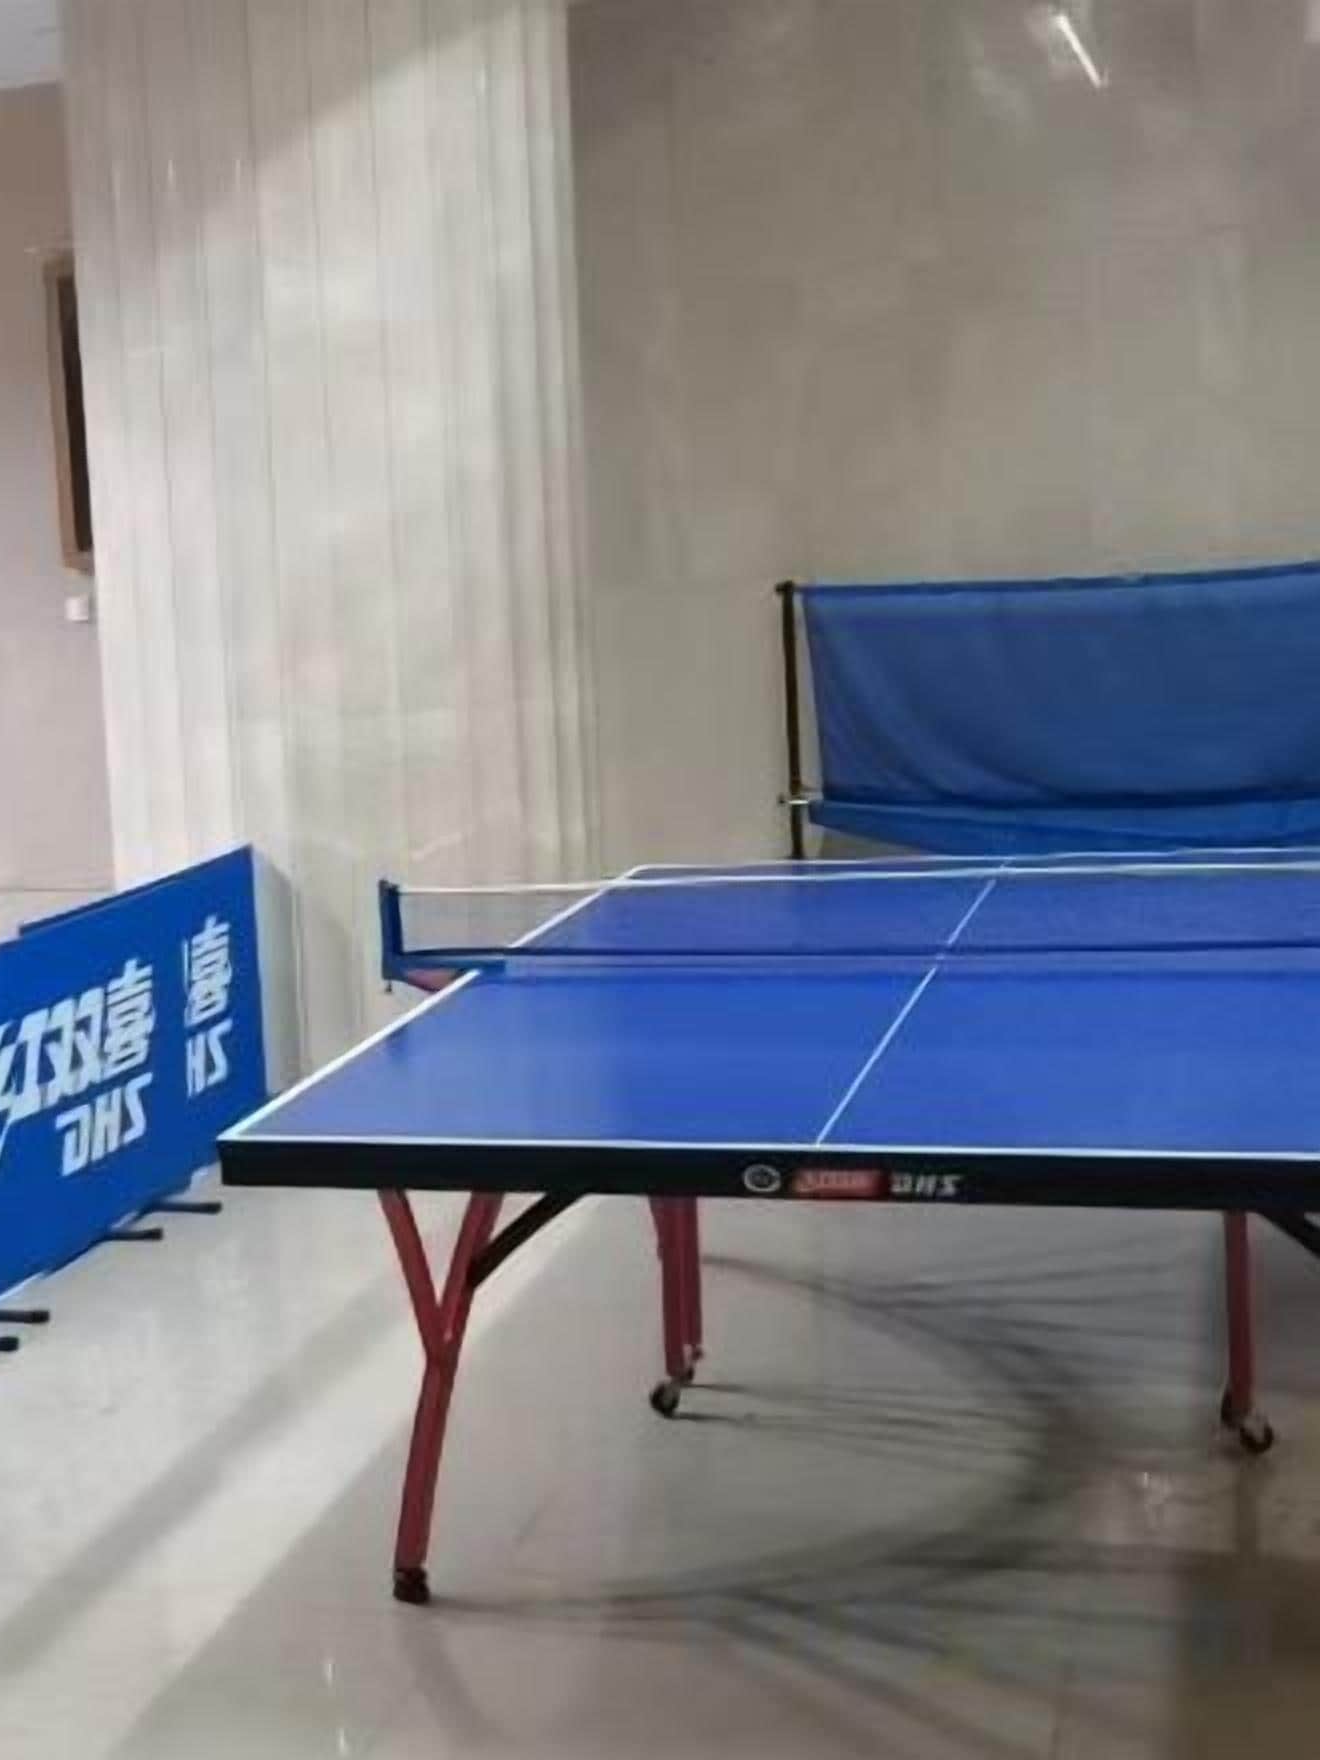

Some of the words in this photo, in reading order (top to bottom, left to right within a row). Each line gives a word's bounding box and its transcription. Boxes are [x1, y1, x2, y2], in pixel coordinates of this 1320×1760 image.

[182, 914, 232, 1028] 喜
[186, 1017, 233, 1097] HS
[55, 1071, 153, 1176] DHS
